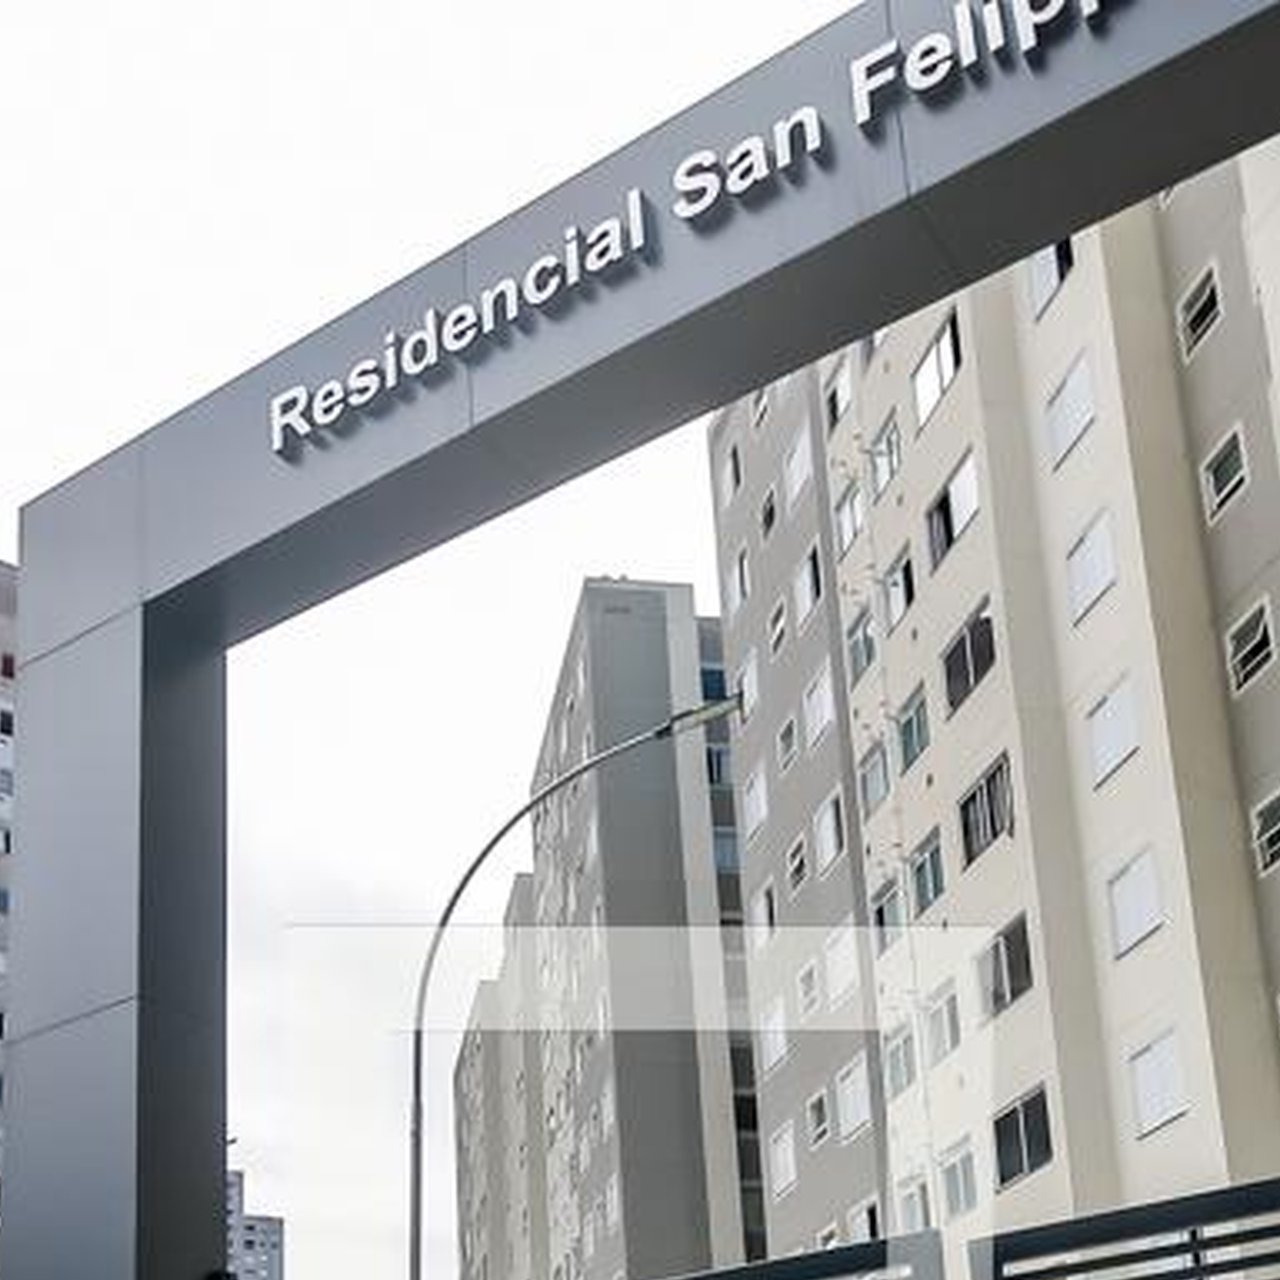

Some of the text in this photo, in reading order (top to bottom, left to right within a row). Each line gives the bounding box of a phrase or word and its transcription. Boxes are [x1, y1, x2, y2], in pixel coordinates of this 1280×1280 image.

[269, 0, 1100, 454] Residencial San Felip
